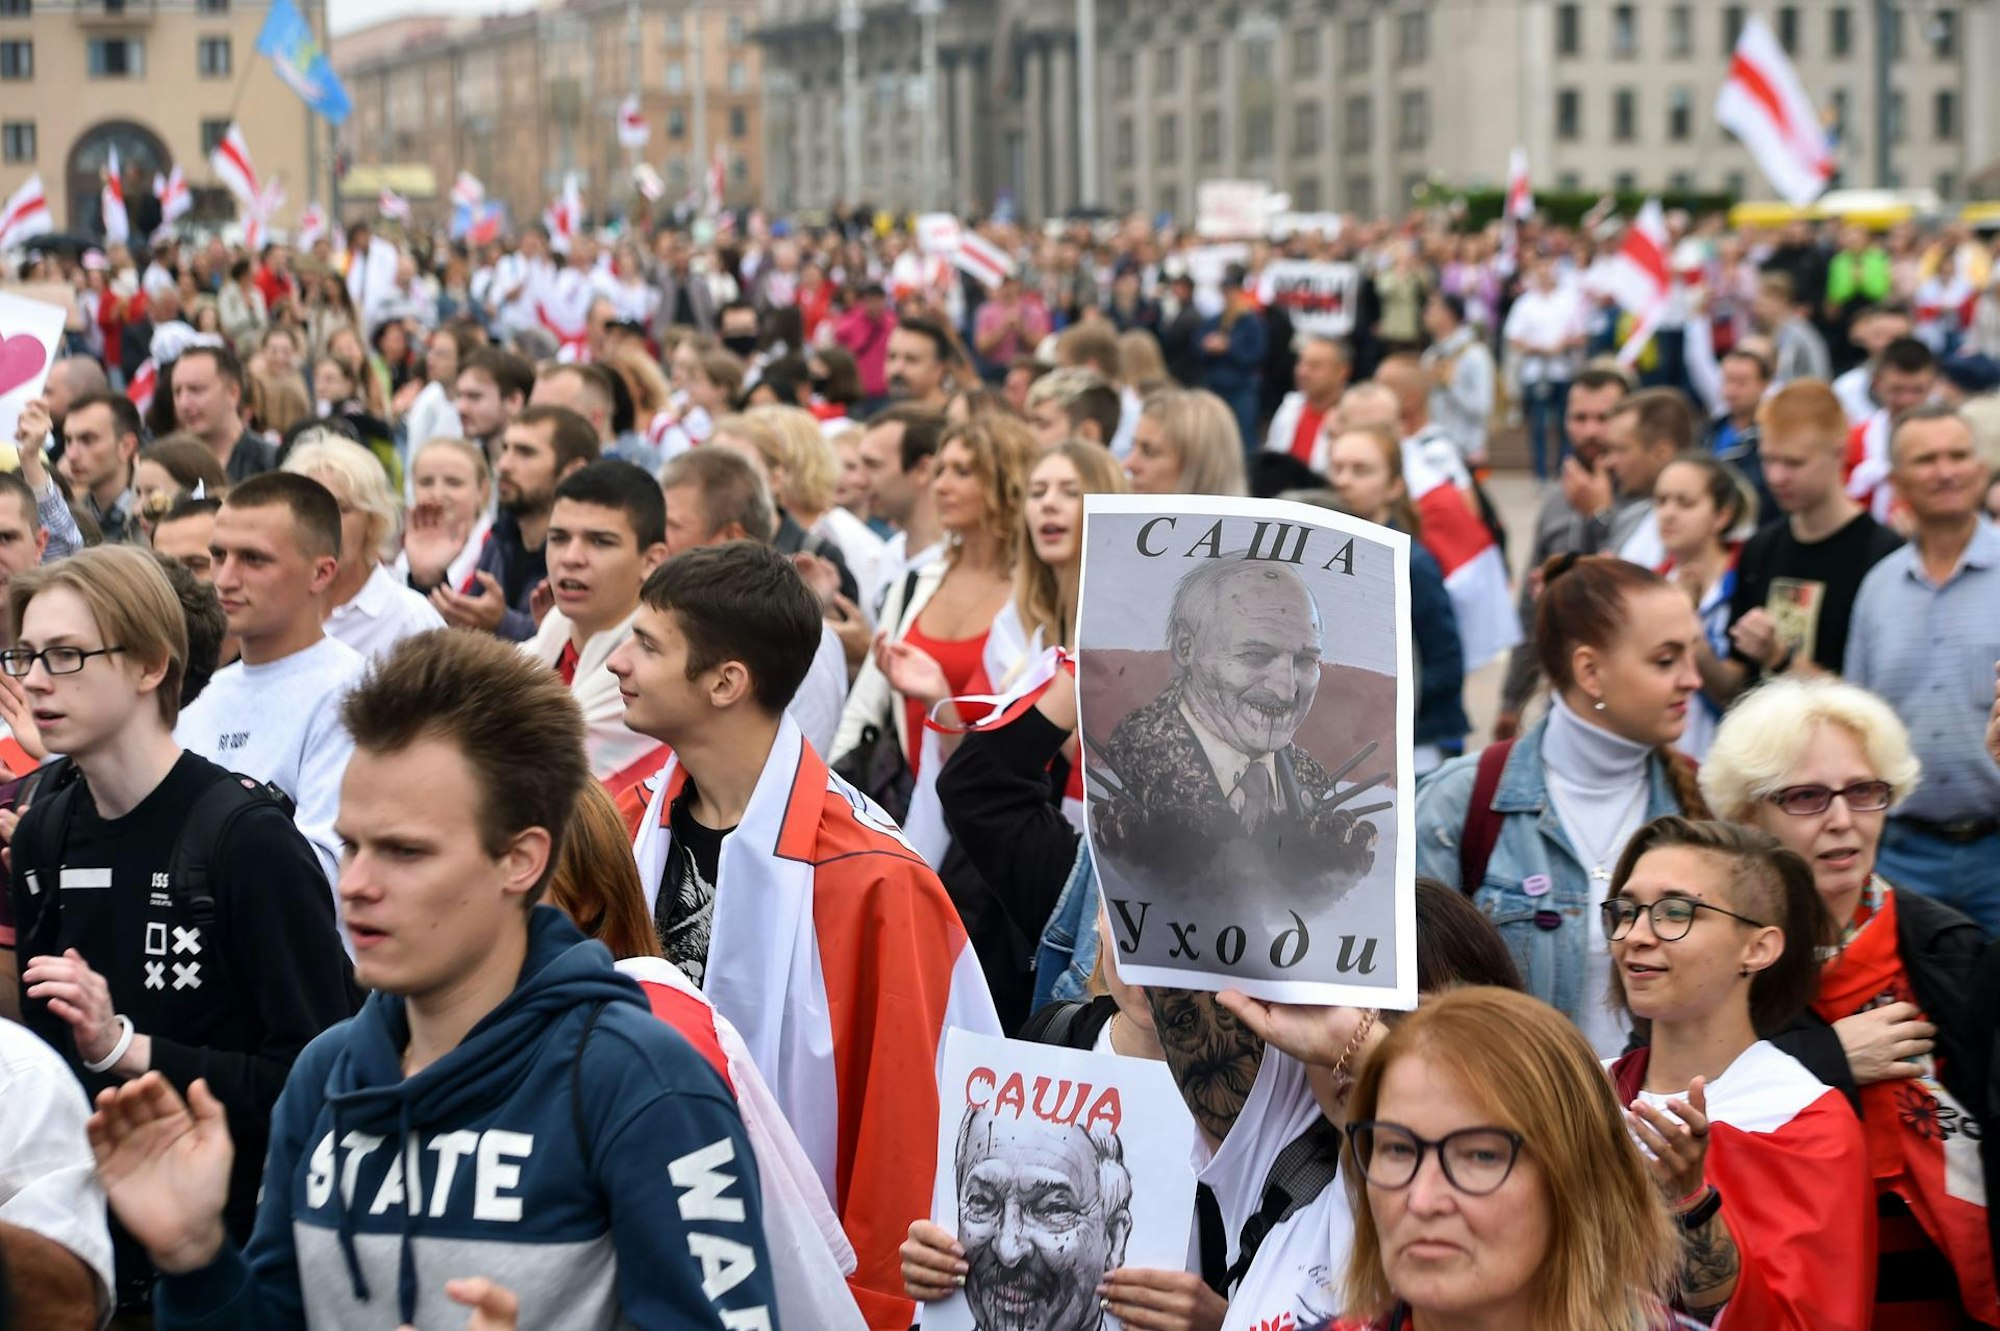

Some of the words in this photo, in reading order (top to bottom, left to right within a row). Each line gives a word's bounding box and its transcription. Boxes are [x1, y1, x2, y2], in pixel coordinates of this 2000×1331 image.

[1135, 516, 1356, 577] САША
[1110, 899, 1378, 975] Уходи
[966, 1067, 1122, 1136] САША
[306, 1128, 534, 1222] STATE
